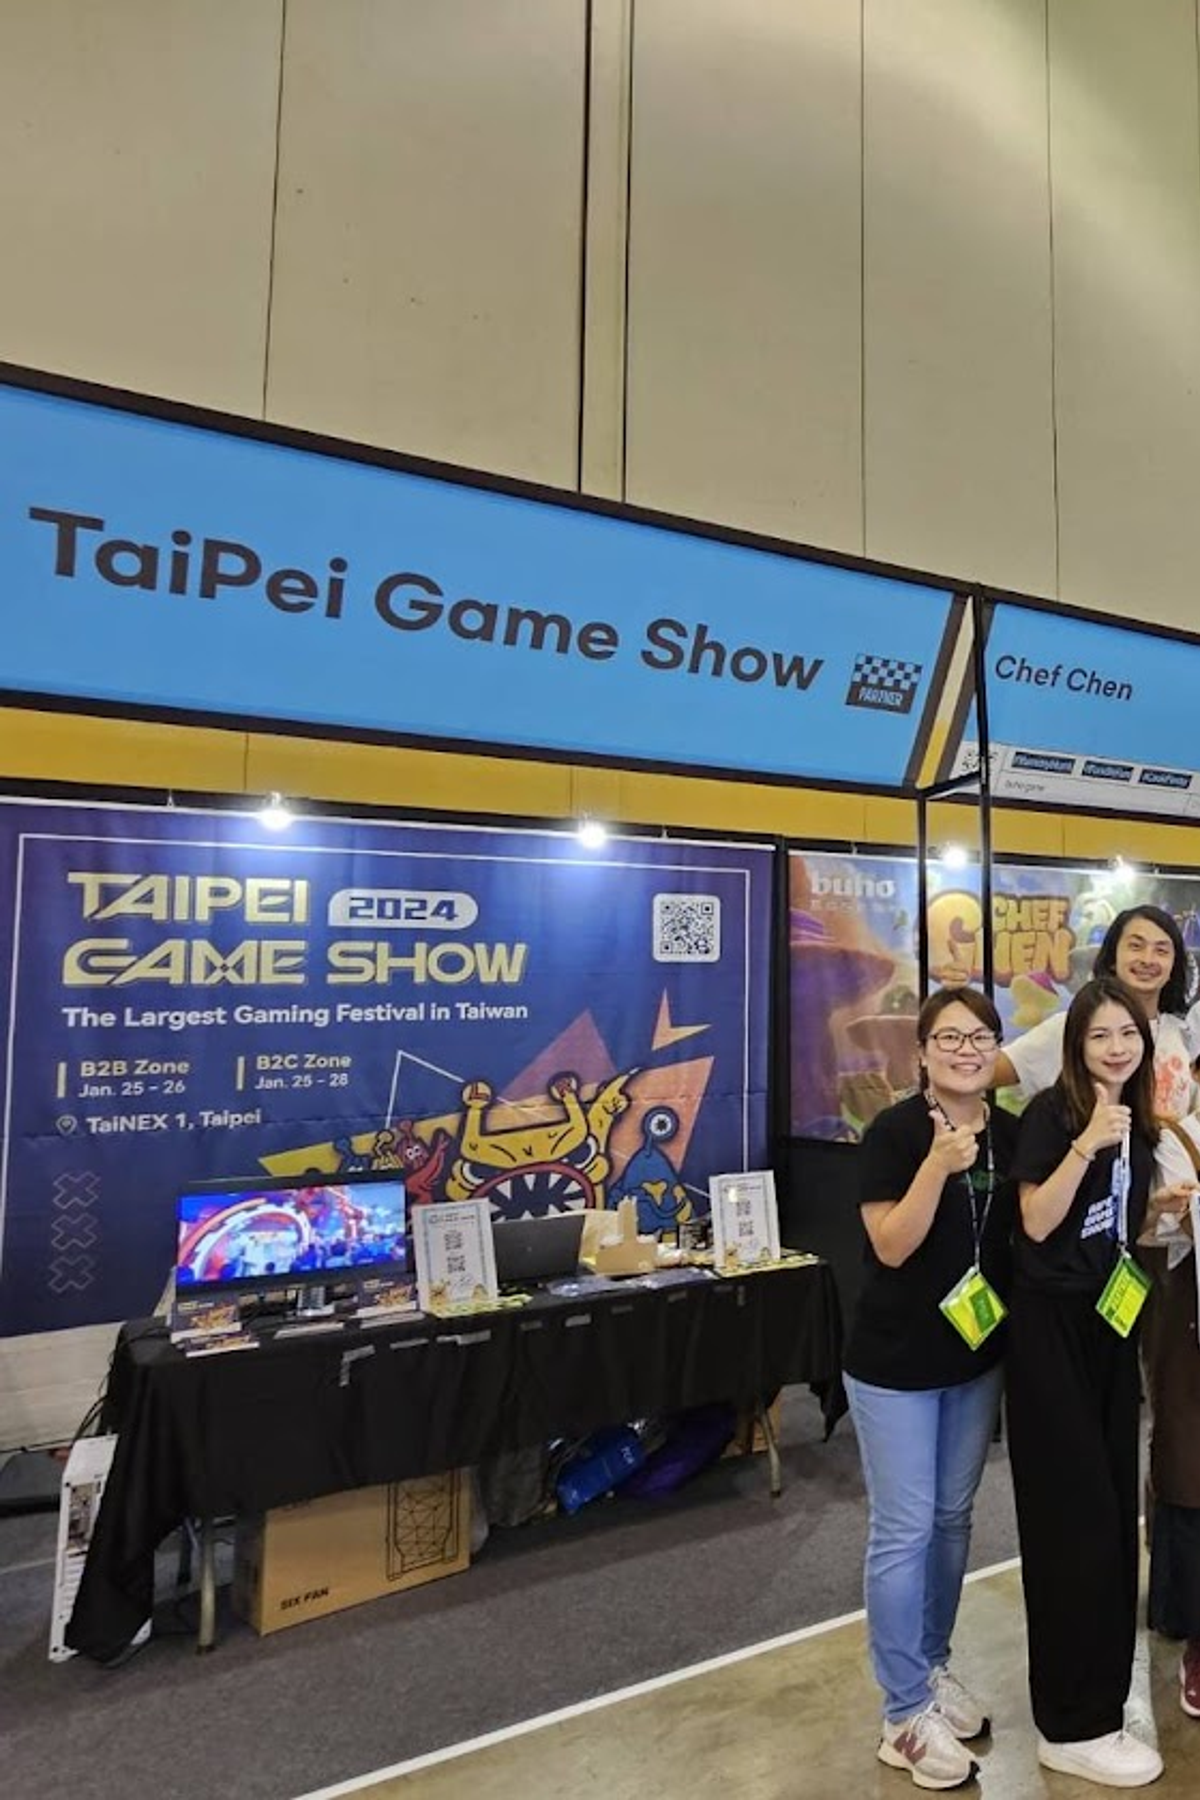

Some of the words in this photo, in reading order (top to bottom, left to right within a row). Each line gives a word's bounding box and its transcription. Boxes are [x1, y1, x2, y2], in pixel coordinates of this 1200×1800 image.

[30, 507, 348, 619] TaiPei
[374, 571, 619, 661] Game
[640, 617, 824, 691] Show
[994, 654, 1064, 688] Chef
[1066, 667, 1134, 701] Chen
[858, 686, 904, 707] PARTNER
[67, 871, 310, 923] TAIPEI
[348, 896, 458, 922] 2024
[63, 938, 306, 985] GAME
[326, 941, 527, 985] SHOW
[62, 1007, 116, 1028] The
[124, 1006, 227, 1030] Largest
[234, 1004, 328, 1027] Gaming
[336, 1003, 425, 1022] Festival
[430, 1003, 450, 1020] in
[455, 1001, 528, 1020] Taiwan
[80, 1061, 127, 1078] B2B
[133, 1059, 190, 1076] Zone
[256, 1055, 299, 1071] B2C
[304, 1053, 352, 1069] Zone
[78, 1083, 117, 1099] Jan.
[122, 1081, 144, 1095] 25
[163, 1079, 186, 1094] 26
[254, 1075, 288, 1090] Jan.
[292, 1074, 312, 1088] 25
[329, 1073, 349, 1087] 28
[86, 1113, 169, 1134] TaiNEX
[175, 1113, 194, 1131] 1,
[199, 1108, 263, 1129] Taipei
[303, 1586, 329, 1602] FAN
